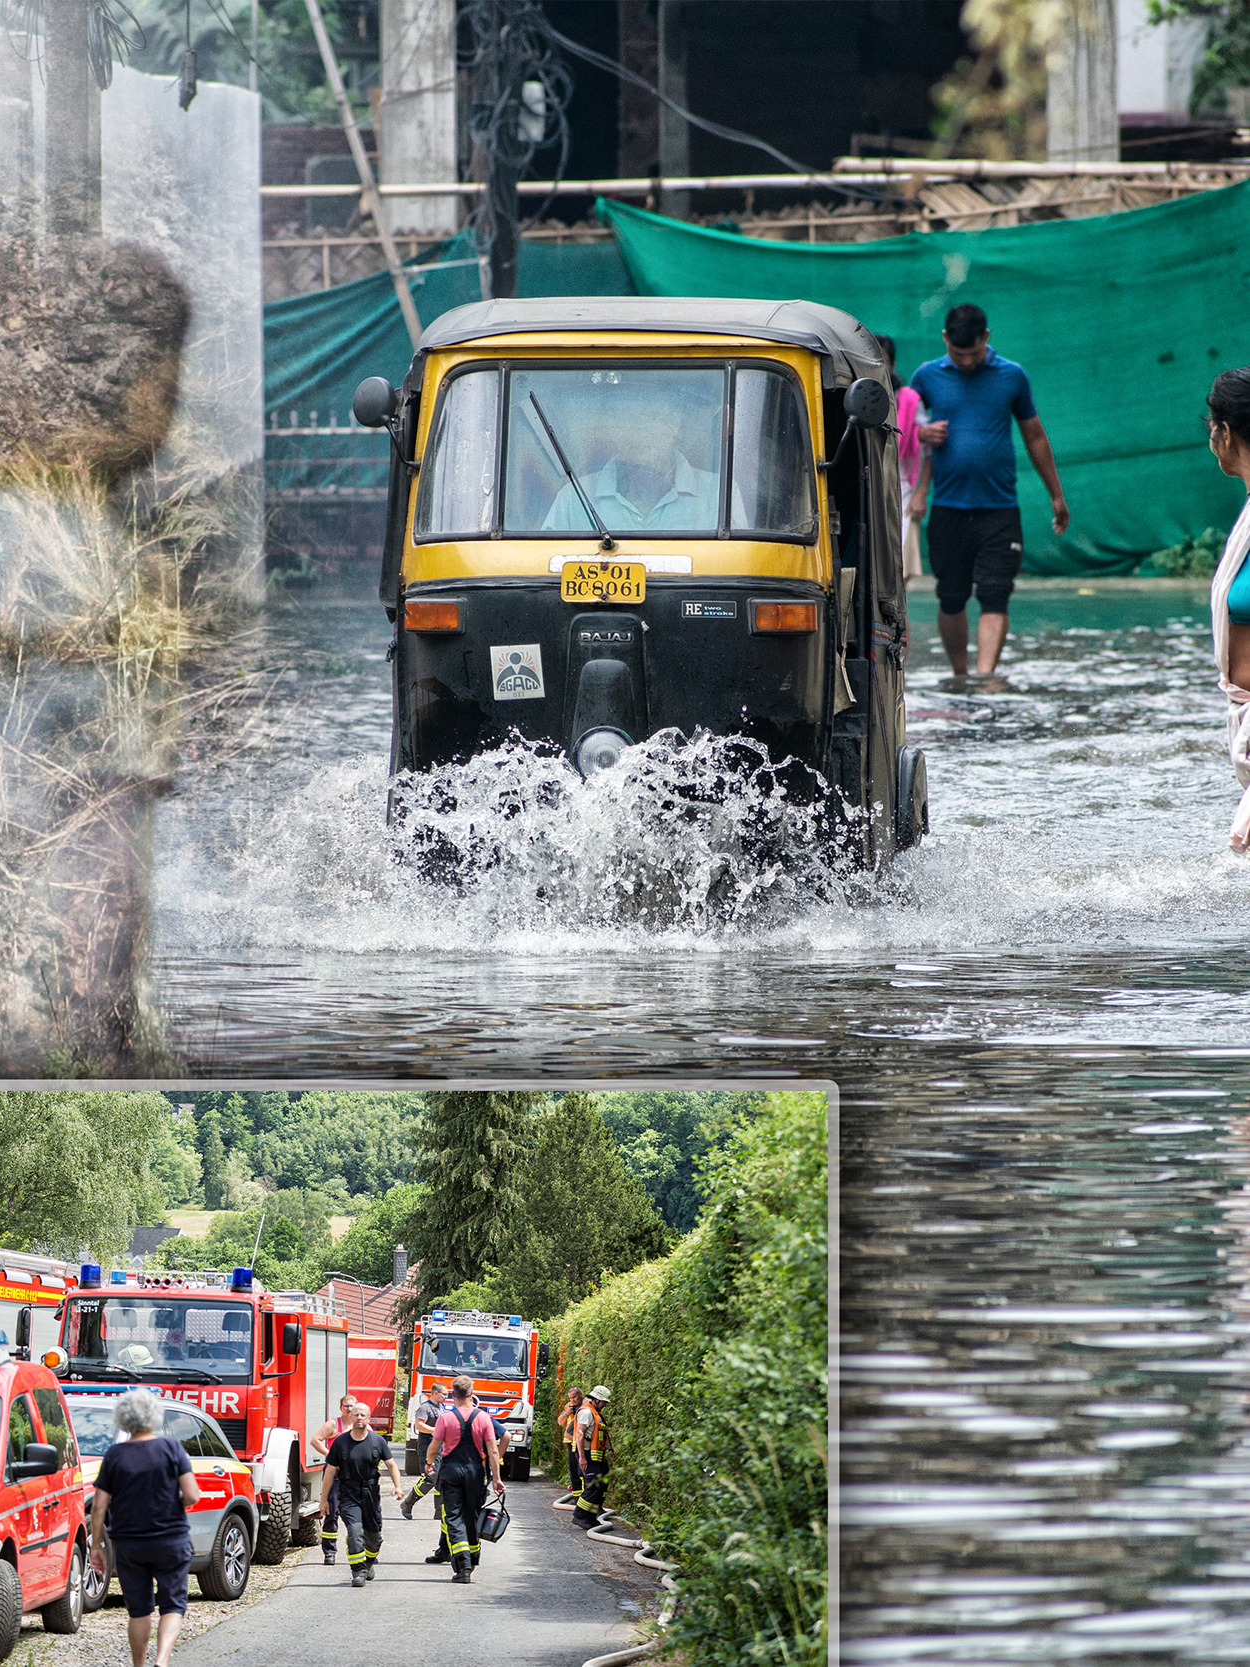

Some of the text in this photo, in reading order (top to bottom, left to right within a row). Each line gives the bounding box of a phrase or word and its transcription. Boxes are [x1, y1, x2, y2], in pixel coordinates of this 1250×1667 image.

[574, 565, 632, 580] AS 01
[685, 603, 703, 616] RE
[579, 632, 632, 642] BAJAJ
